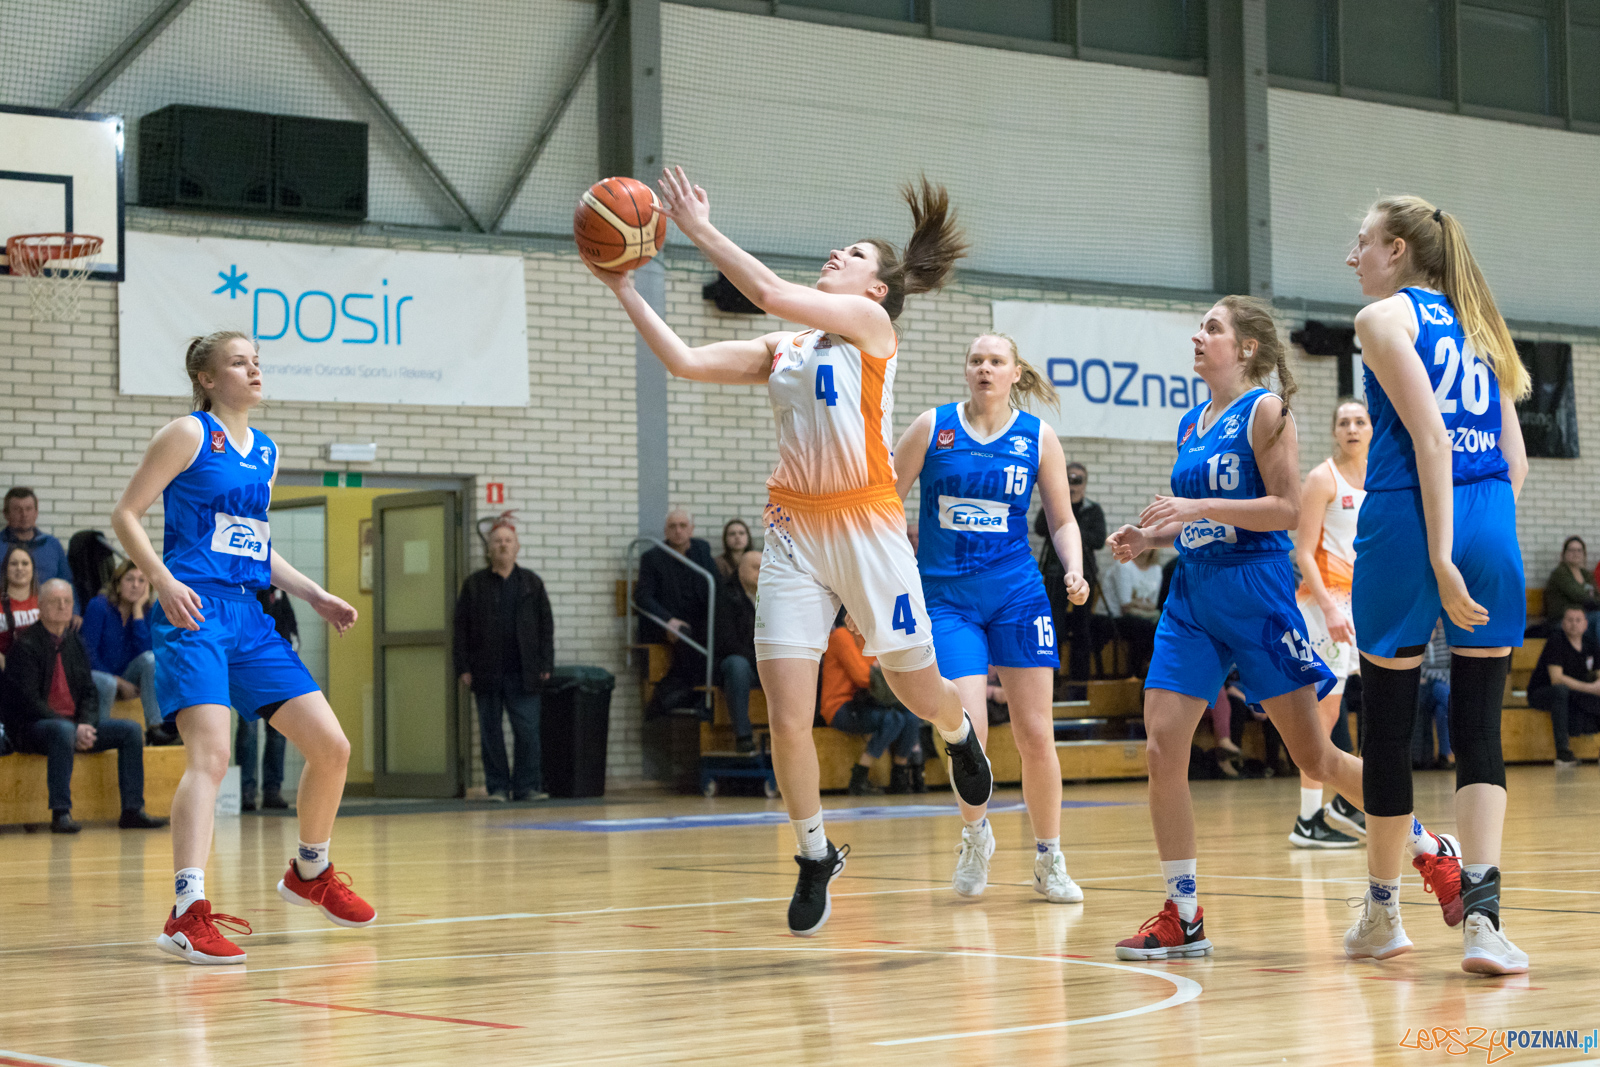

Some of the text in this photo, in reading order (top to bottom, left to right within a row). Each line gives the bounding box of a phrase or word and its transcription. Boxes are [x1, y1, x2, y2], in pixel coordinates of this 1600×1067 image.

[1418, 303, 1453, 326] AZS
[815, 364, 839, 407] 4
[1433, 336, 1490, 416] 26
[1003, 464, 1029, 496] 15
[1206, 452, 1241, 491] 13
[952, 511, 1002, 526] Enea
[1184, 525, 1227, 543] Enea
[891, 593, 918, 635] 4
[1033, 616, 1054, 648] 15
[1280, 628, 1314, 662] 13
